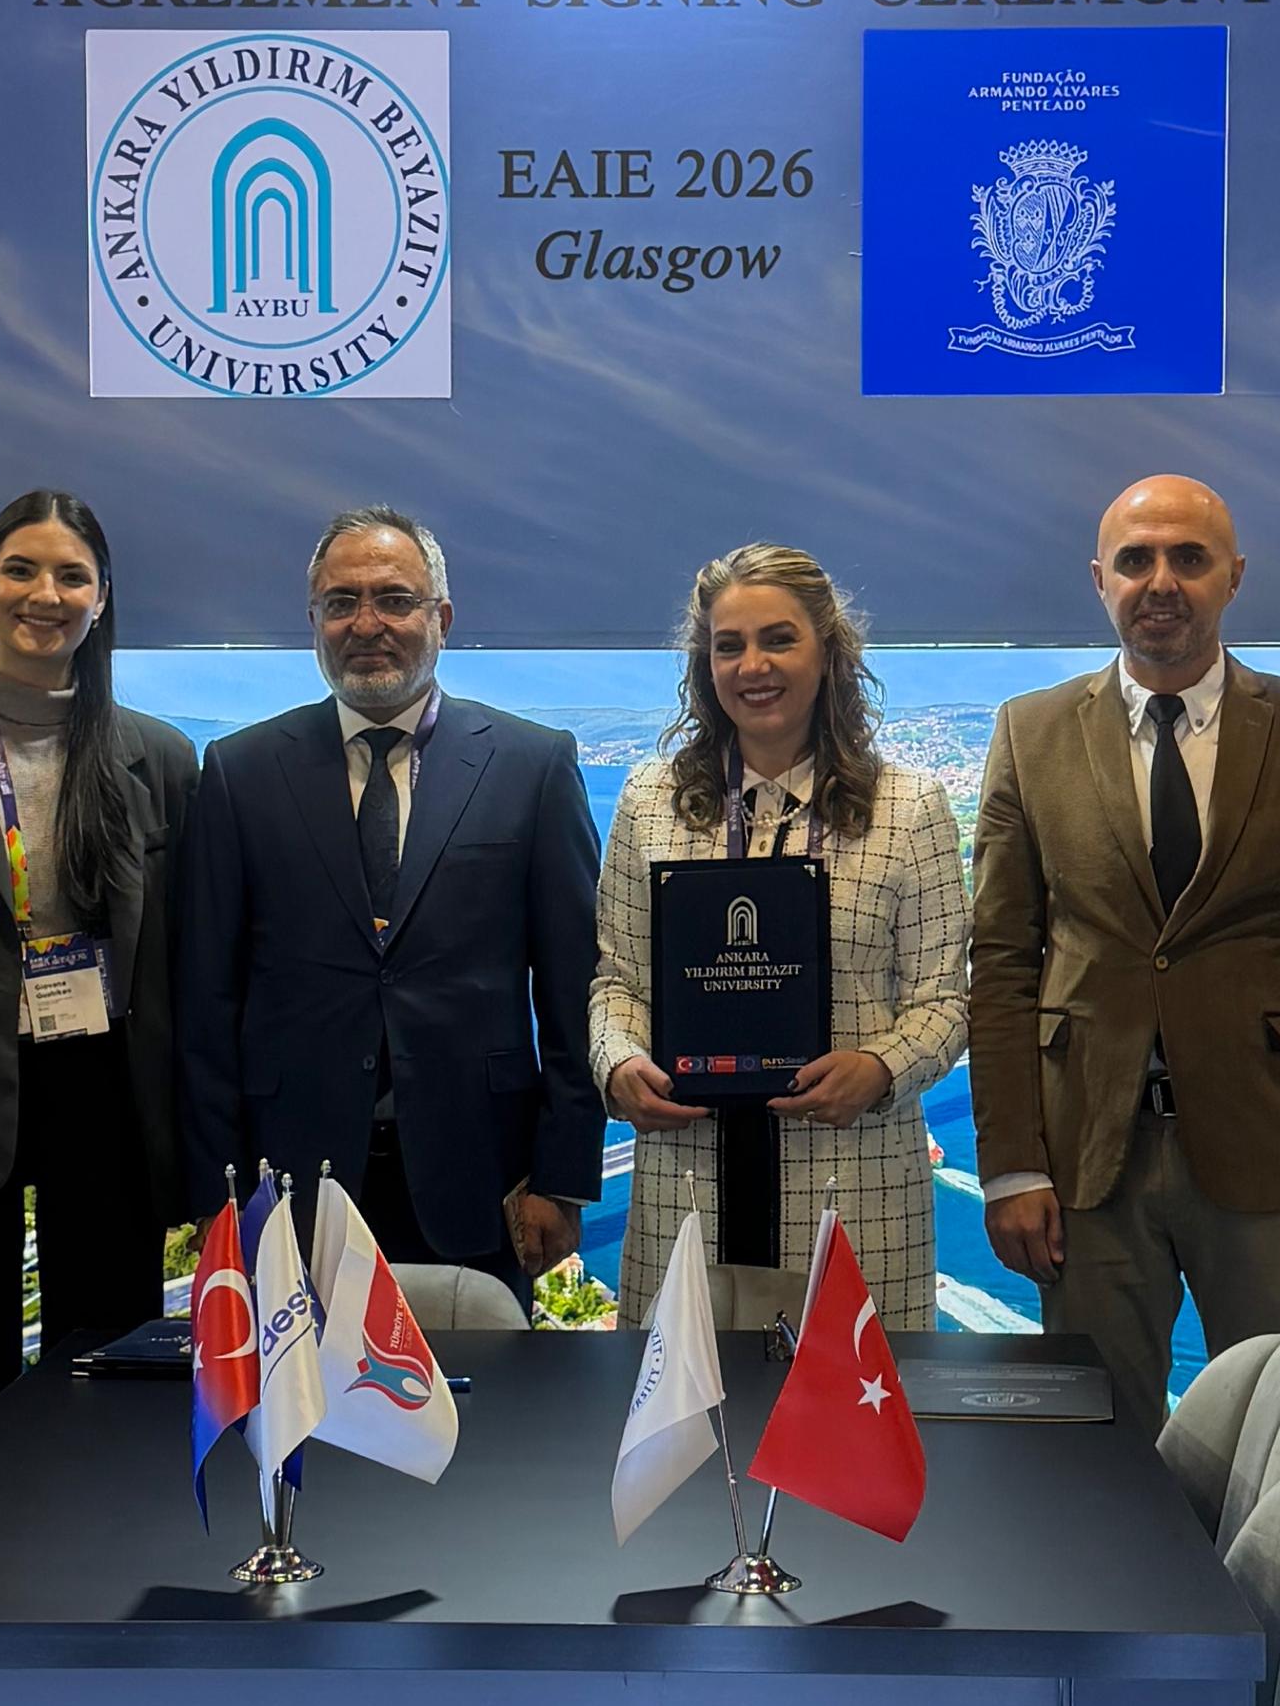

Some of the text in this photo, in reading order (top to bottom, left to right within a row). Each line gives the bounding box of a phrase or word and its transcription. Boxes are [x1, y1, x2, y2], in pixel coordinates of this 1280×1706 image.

[1002, 69, 1086, 85] FUNDAÇÃO
[968, 84, 1120, 98] ARMANDO ALVARES
[1001, 99, 1087, 111] PENTEADO
[104, 46, 440, 288] ANKARA YILDIRIM BEYAZIT
[498, 148, 814, 200] EAIE 2026
[535, 229, 781, 291] Glasgow
[235, 298, 309, 317] AYBU
[148, 314, 400, 395] UNIVERSITY
[716, 952, 769, 964] ANKARA
[684, 964, 802, 979] YILDIRIM BEYAZIT
[703, 979, 783, 992] UNIVERSITY
